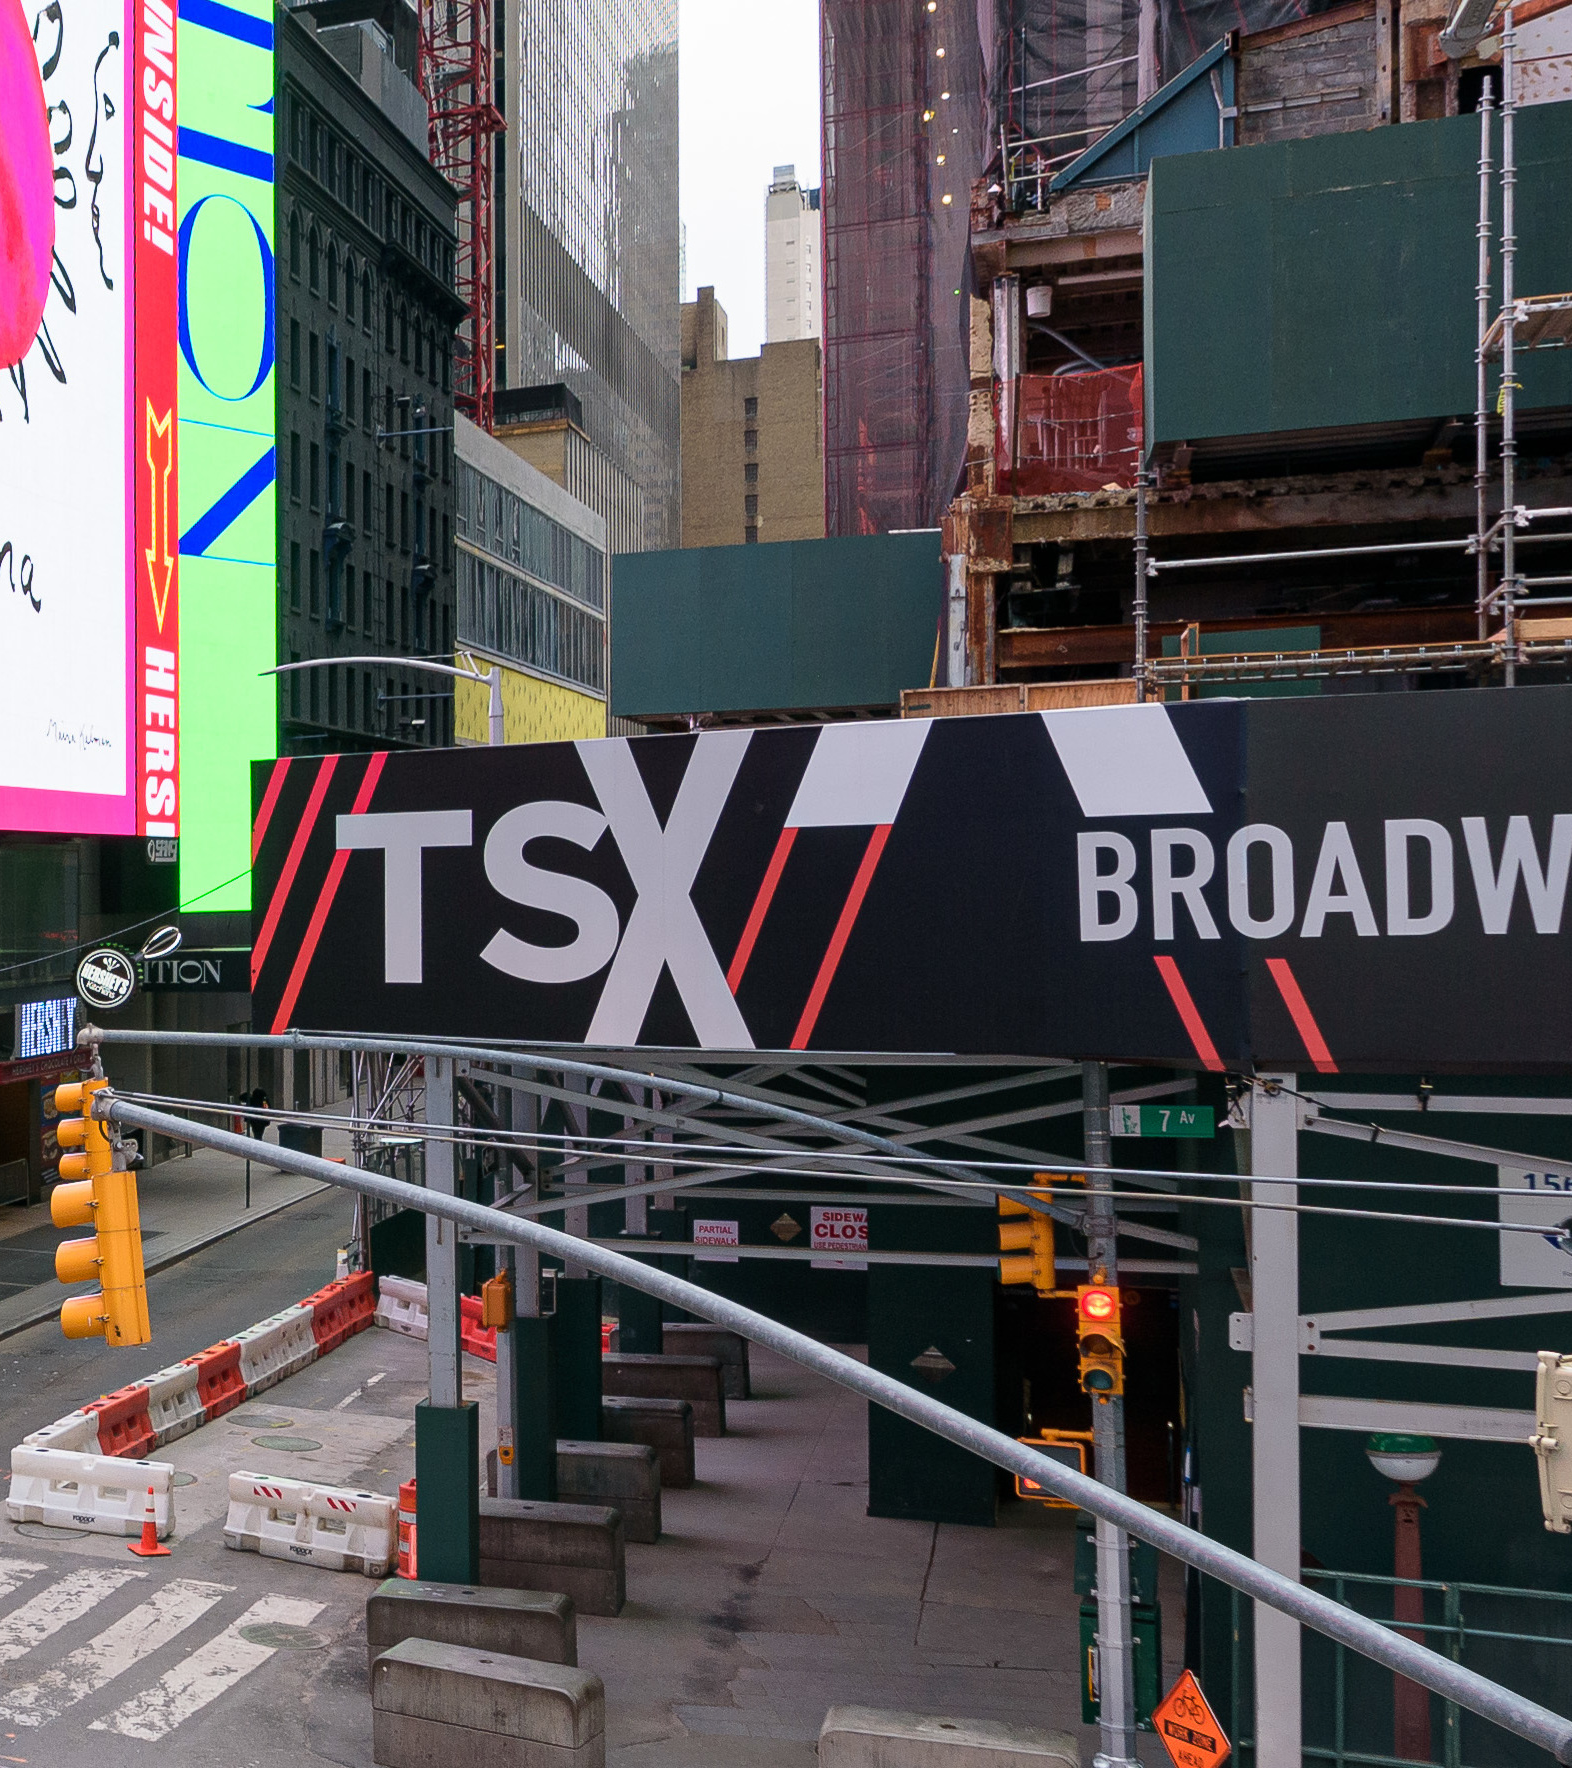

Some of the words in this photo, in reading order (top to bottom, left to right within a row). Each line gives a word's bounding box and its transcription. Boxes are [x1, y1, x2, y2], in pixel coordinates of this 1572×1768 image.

[1078, 814, 1572, 943] BROADW
[336, 729, 756, 1048] TSX
[81, 963, 130, 994] HERSHEY'S
[144, 959, 222, 984] ITION
[85, 980, 116, 999] Kitchens
[1158, 1110, 1171, 1132] 7
[1180, 1110, 1196, 1125] Av
[822, 1211, 868, 1223] SIDEW
[699, 1226, 732, 1235] PARTIAL
[813, 1223, 868, 1240] CLOS
[695, 1236, 737, 1245] SIDEWALK
[813, 1241, 826, 1250] USE
[1167, 1723, 1190, 1744] WORK
[1178, 1749, 1205, 1767] AHEAD
